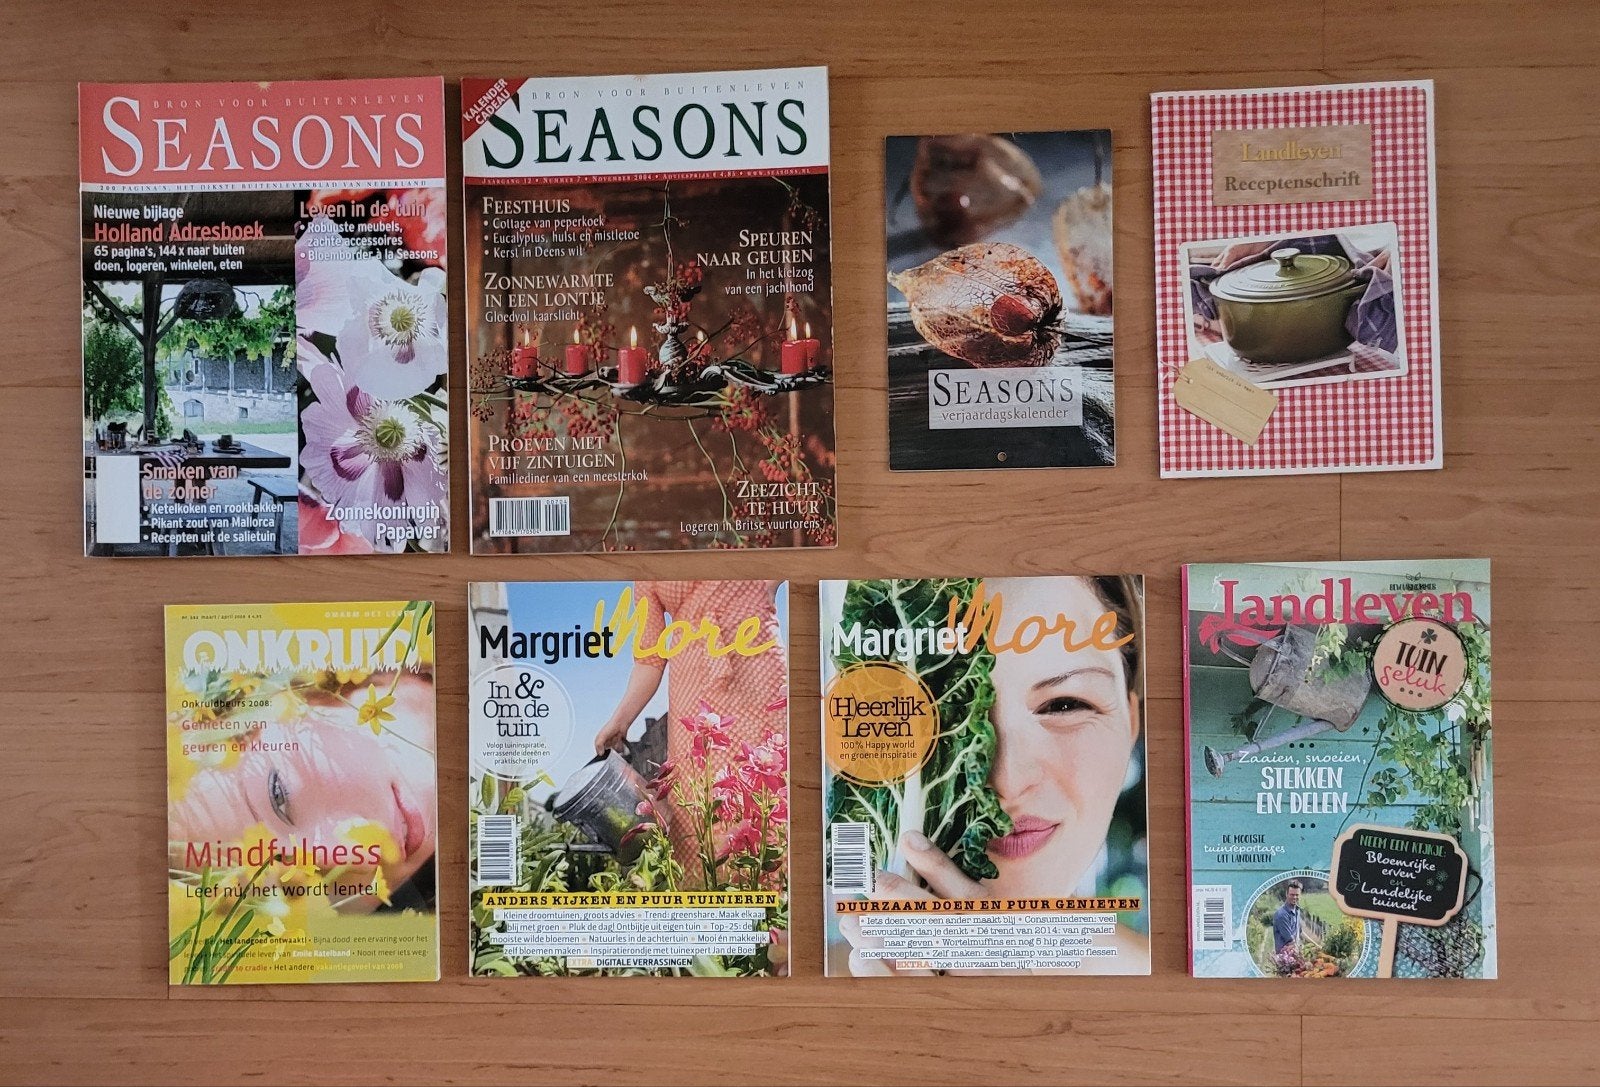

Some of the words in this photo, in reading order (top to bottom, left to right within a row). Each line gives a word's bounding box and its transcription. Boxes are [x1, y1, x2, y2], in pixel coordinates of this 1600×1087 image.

[532, 90, 582, 99] BRON
[664, 81, 804, 95] BUITENLEVEN
[463, 78, 508, 122] KALENDER
[475, 90, 511, 125] CADEAU
[102, 96, 425, 177] SEASONS
[482, 92, 807, 169] SEASONS
[1241, 141, 1343, 162] Landleven
[1225, 170, 1361, 194] Receptenschrift
[94, 205, 140, 219] Nieuwe
[143, 205, 184, 222] bijlage
[300, 201, 346, 218] Leven
[351, 200, 364, 217] in
[370, 201, 390, 217] de
[482, 197, 570, 215] FEESTHUIS
[94, 222, 163, 242] Holland
[169, 220, 265, 241] Adresboek
[308, 222, 355, 233] Robuuste
[358, 221, 403, 233] meubels,
[492, 217, 531, 232] Cottage
[554, 215, 605, 231] peperkoek
[307, 236, 342, 247] zachte
[345, 236, 403, 246] accessoires
[552, 232, 576, 242] hulst
[594, 229, 640, 241] mistletoe
[739, 229, 813, 247] SPEUREN
[94, 245, 108, 257] 65
[111, 246, 157, 259] pagina's,
[187, 246, 210, 256] naar
[213, 244, 245, 255] buiten
[308, 250, 373, 261] Bloemborder
[397, 249, 438, 259] Seasons
[493, 247, 518, 258] Kerst
[535, 247, 565, 258] Deens
[697, 252, 741, 267] NAAR
[747, 249, 813, 265] GEUREN
[94, 260, 124, 273] doen,
[127, 260, 167, 273] logeren,
[170, 259, 217, 272] winkelen,
[219, 259, 242, 270] eten
[760, 268, 774, 279] het
[778, 267, 814, 281] kielzog
[484, 272, 614, 290] ZONNEWARMTE
[725, 286, 742, 295] van
[766, 280, 814, 297] jachthond
[485, 294, 502, 308] IN
[508, 294, 538, 308] EEN
[545, 292, 605, 307] LONTJE
[485, 310, 530, 323] Gloedvol
[533, 310, 580, 321] kaarslicht
[933, 373, 1073, 406] SEASONS
[942, 406, 1069, 423] verjaardagskalender
[489, 434, 566, 452] PROEVEN
[572, 436, 604, 450] MET
[489, 456, 520, 470] VIJF
[527, 453, 615, 469] ZINTUIGEN
[143, 463, 204, 481] Smaken
[209, 465, 238, 479] van
[489, 474, 549, 485] Familiediner
[593, 469, 648, 481] meesterkok
[168, 481, 218, 499] zomer
[737, 480, 819, 498] ZEEZICHT
[151, 504, 207, 514] Ketelkoken
[224, 503, 283, 513] rookbakken
[325, 502, 440, 524] Zonnekoningin
[747, 502, 767, 516] TE
[773, 500, 819, 515] HUUR
[151, 517, 183, 529] Pikant
[186, 518, 208, 528] zout
[211, 519, 230, 527] van
[232, 517, 275, 527] Mallorca
[681, 521, 719, 535] Logeren
[736, 520, 764, 530] Britse
[767, 518, 820, 529] vuurtorens
[151, 532, 198, 545] Recepten
[233, 531, 276, 542] salietuin
[376, 524, 440, 542] Papaver
[480, 625, 614, 664] Margriet
[593, 586, 777, 659] More
[833, 621, 967, 661] Margriet
[946, 581, 1135, 655] More
[180, 628, 421, 674] ONKRUID
[1396, 641, 1448, 675] TUIN
[488, 681, 511, 699] In
[515, 673, 544, 699] &
[181, 700, 246, 709] Onkruidbeurs
[484, 700, 521, 718] Om
[524, 700, 549, 717] de
[829, 693, 926, 721] (H)eerlijk
[181, 720, 240, 731] Genieten
[244, 721, 267, 729] van
[496, 719, 540, 737] tuin
[842, 718, 913, 737] Leven
[182, 743, 228, 755] geuren
[251, 740, 299, 752] kleuren
[866, 741, 890, 750] Happy
[893, 740, 914, 748] world
[851, 752, 879, 761] groene
[881, 750, 917, 760] inspiratie
[1239, 751, 1299, 769] Zaaien,
[1306, 752, 1367, 765] snoeien,
[1261, 767, 1343, 789] STEKKEN
[1257, 792, 1282, 814] EN
[1290, 792, 1348, 814] DELEN
[1204, 844, 1286, 856] tuinreportages
[1360, 835, 1387, 849] NEEM
[185, 838, 381, 868] Mindfulness
[1366, 851, 1436, 873] Bloemrijke
[1382, 868, 1416, 879] erven
[185, 884, 218, 898] Leef
[252, 884, 277, 897] het
[282, 883, 329, 897] wordt
[334, 881, 378, 896] lente!
[1361, 882, 1432, 904] Landelijke
[486, 896, 548, 905] ANDERS
[552, 896, 611, 905] KIJKEN
[616, 896, 636, 904] EN
[642, 896, 683, 904] PUUR
[687, 895, 776, 904] TUINIEREN
[837, 901, 927, 911] DUURZAAM
[933, 901, 975, 910] DOEN
[981, 901, 1001, 909] EN
[1007, 900, 1050, 909] PUUR
[1056, 899, 1139, 908] GENIETEN
[1373, 897, 1417, 911] tuinen
[504, 911, 527, 919] Kleine
[583, 911, 608, 921] groots
[617, 922, 649, 932] Ontbijtje
[711, 922, 741, 931] Top-25:
[546, 934, 579, 942] bloemen
[589, 934, 626, 942] Natuurles
[649, 934, 688, 942] achtertuin
[520, 946, 553, 954] bloemen
[555, 946, 581, 954] maken
[591, 946, 651, 954] Inspiratierondje
[861, 951, 924, 959] snoeprecepten
